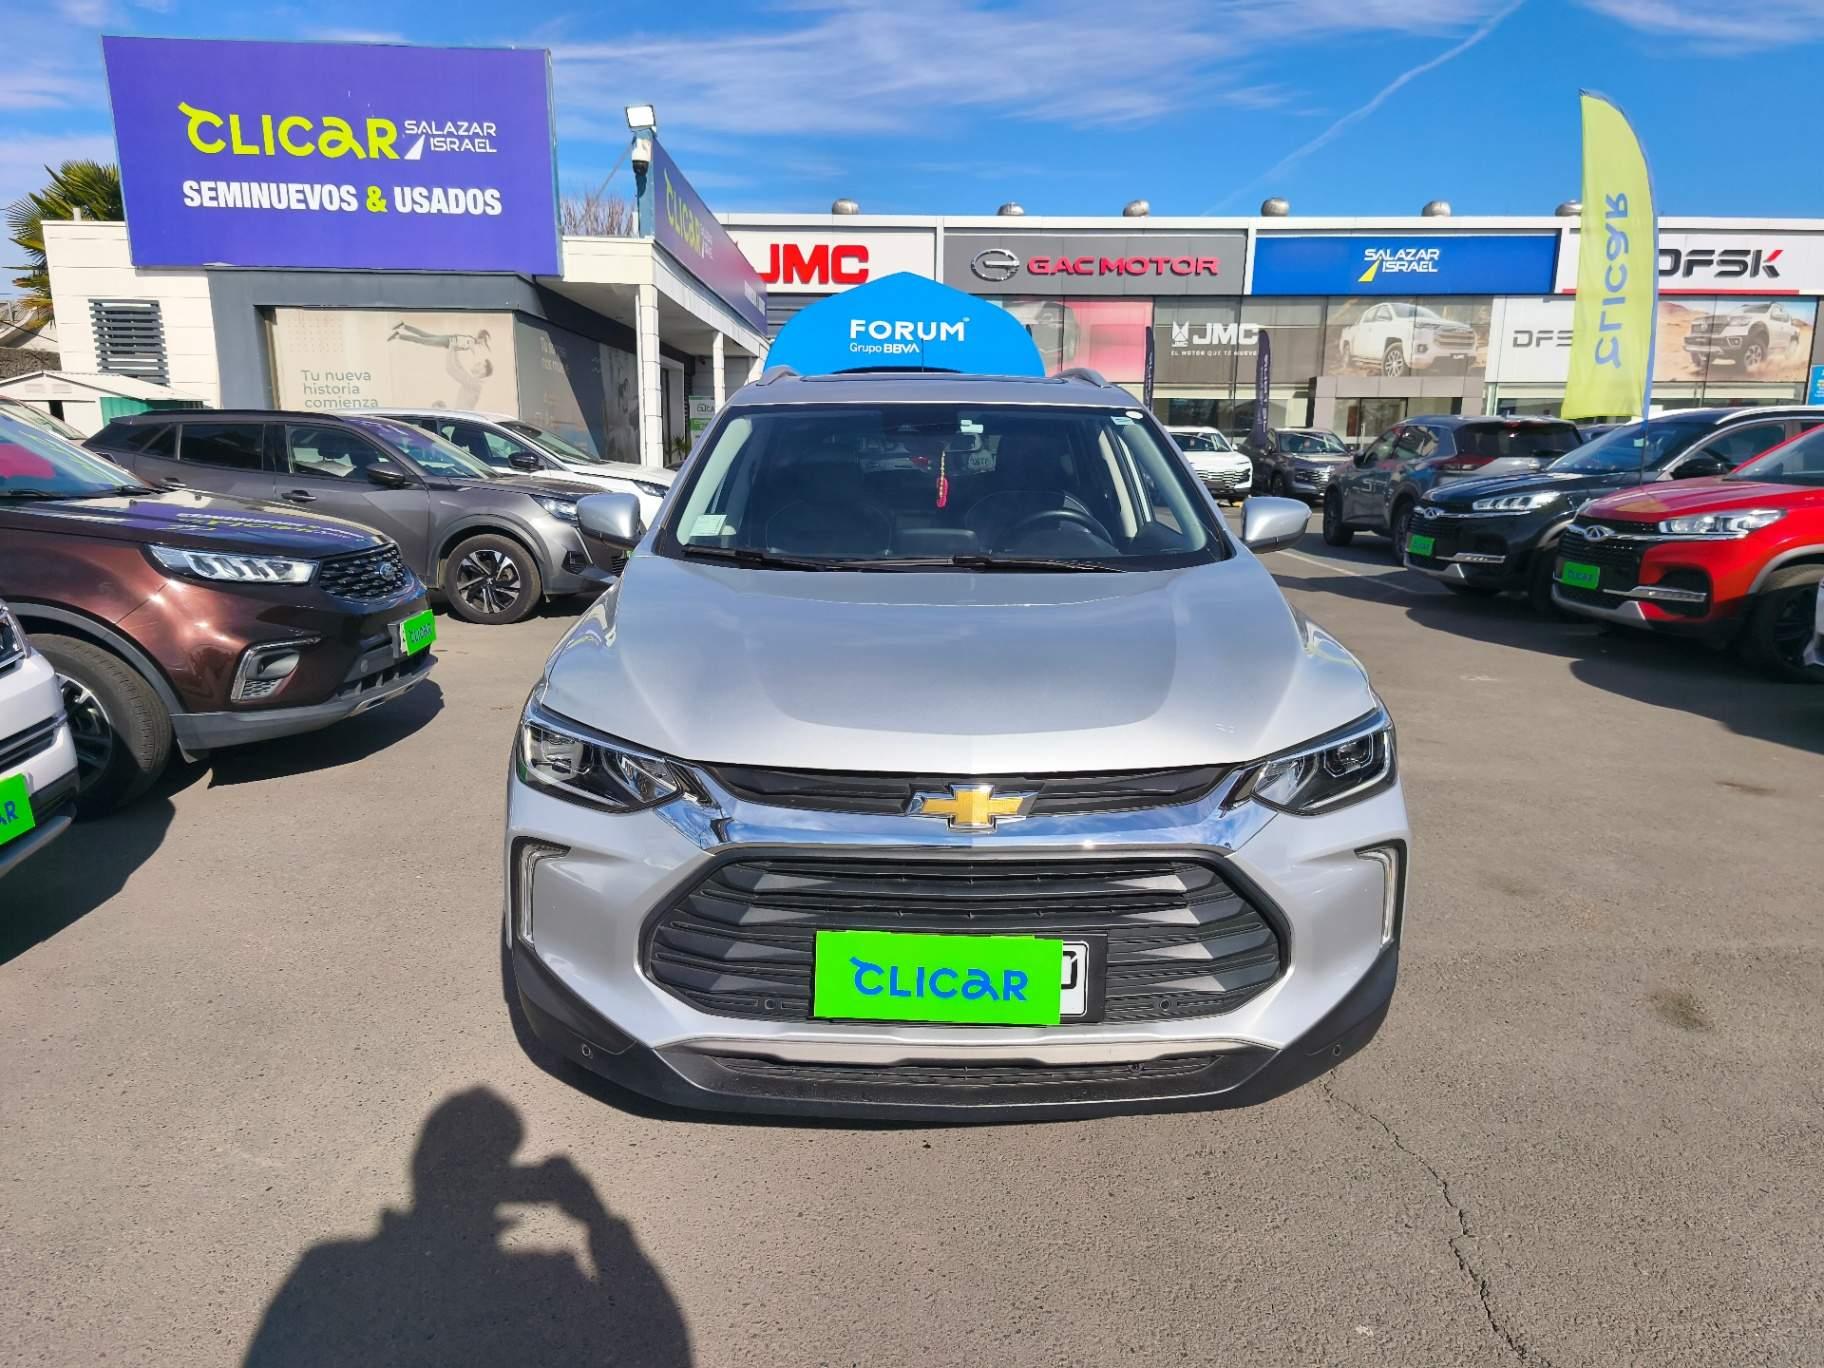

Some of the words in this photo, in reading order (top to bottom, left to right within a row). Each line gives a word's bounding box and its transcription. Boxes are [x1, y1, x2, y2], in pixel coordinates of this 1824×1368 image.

[404, 119, 497, 137] SALAZAR
[430, 137, 497, 153] ISRAEL
[182, 180, 358, 212] SEMINUEVOS
[366, 185, 387, 213] &
[394, 186, 502, 216] USADOS
[1364, 248, 1440, 261] SALAZAR
[1658, 248, 1784, 278] DFSK
[758, 243, 870, 285] JMC
[1027, 256, 1095, 275] GAC
[1099, 256, 1222, 276] MOTOR
[1382, 261, 1438, 272] ISRAEL
[849, 319, 965, 341] FORUM
[1192, 322, 1259, 345] JMC
[1512, 330, 1574, 348] DFS
[849, 342, 882, 354] Grupo
[883, 343, 920, 354] BBVA
[300, 369, 320, 381] Tu
[325, 371, 372, 381] nueva
[303, 382, 361, 395] historia
[304, 395, 379, 408] comienza
